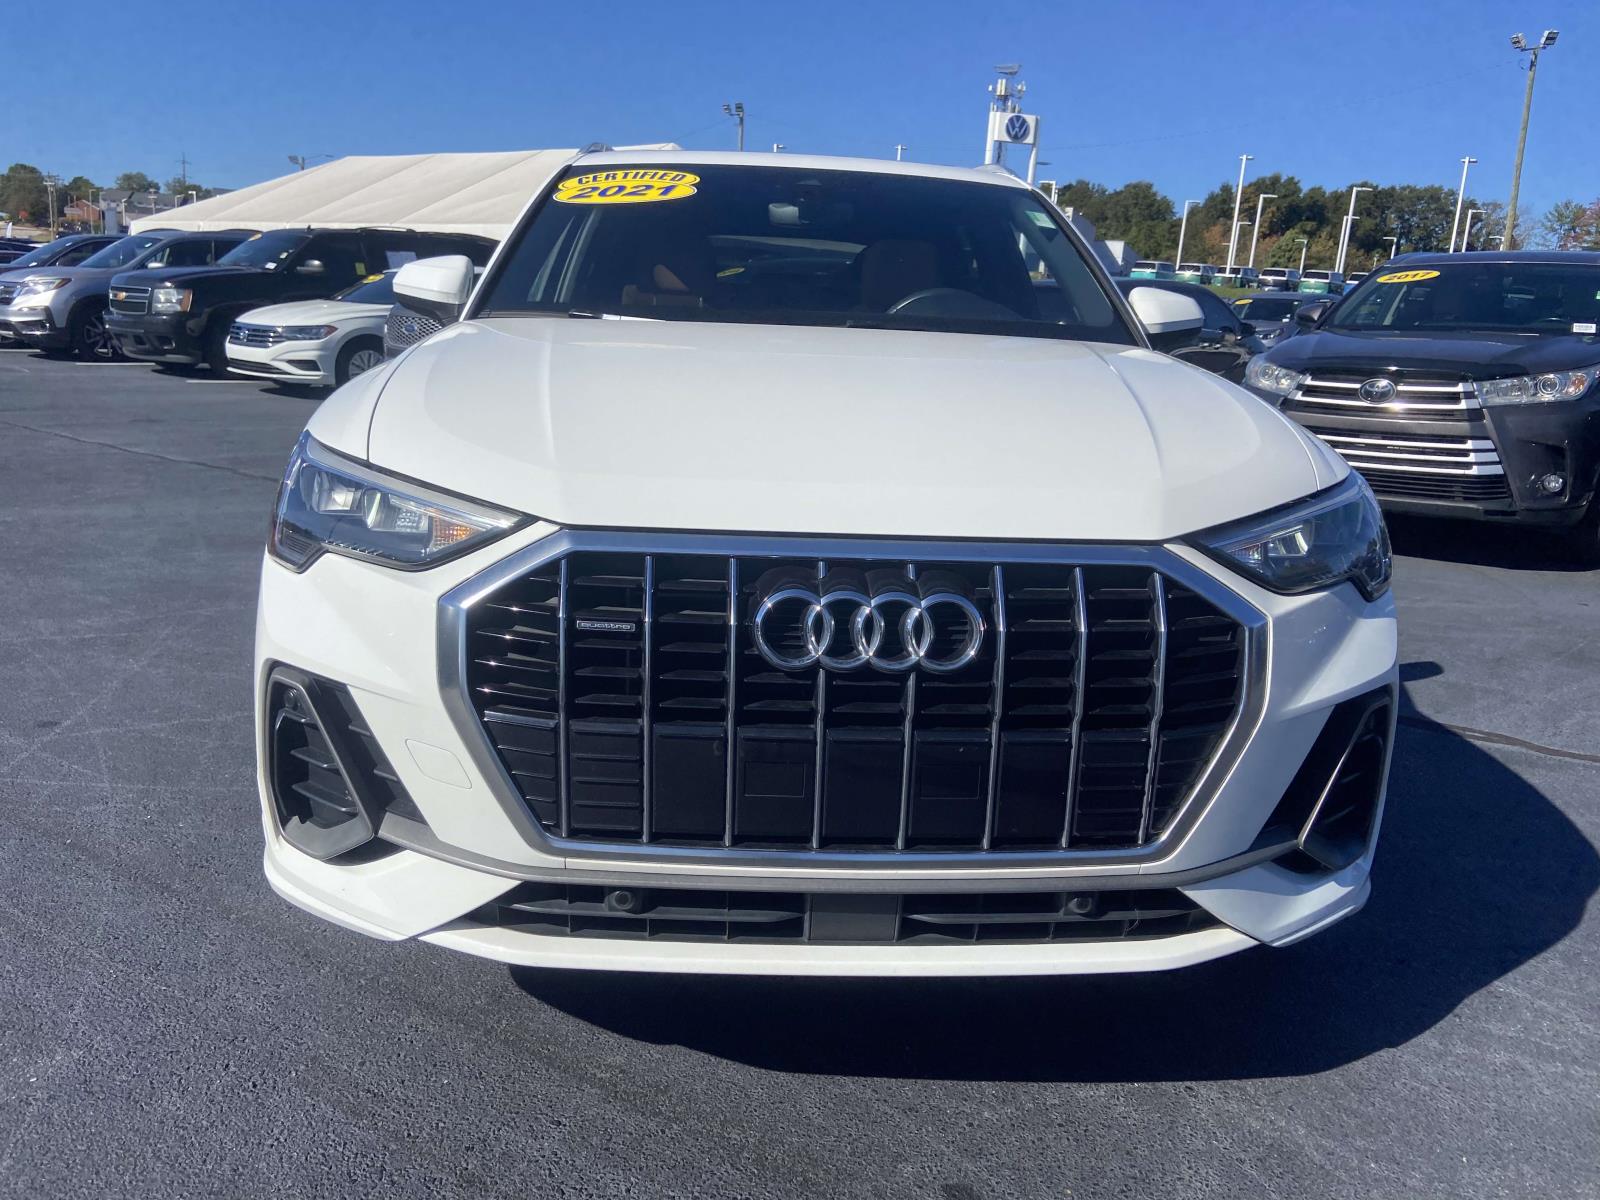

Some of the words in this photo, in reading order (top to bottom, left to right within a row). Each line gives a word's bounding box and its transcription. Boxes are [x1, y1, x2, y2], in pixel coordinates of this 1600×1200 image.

[1007, 115, 1027, 137] VW
[577, 170, 687, 185] CERTIFIED
[568, 184, 677, 200] 2021
[1383, 271, 1433, 282] 2017
